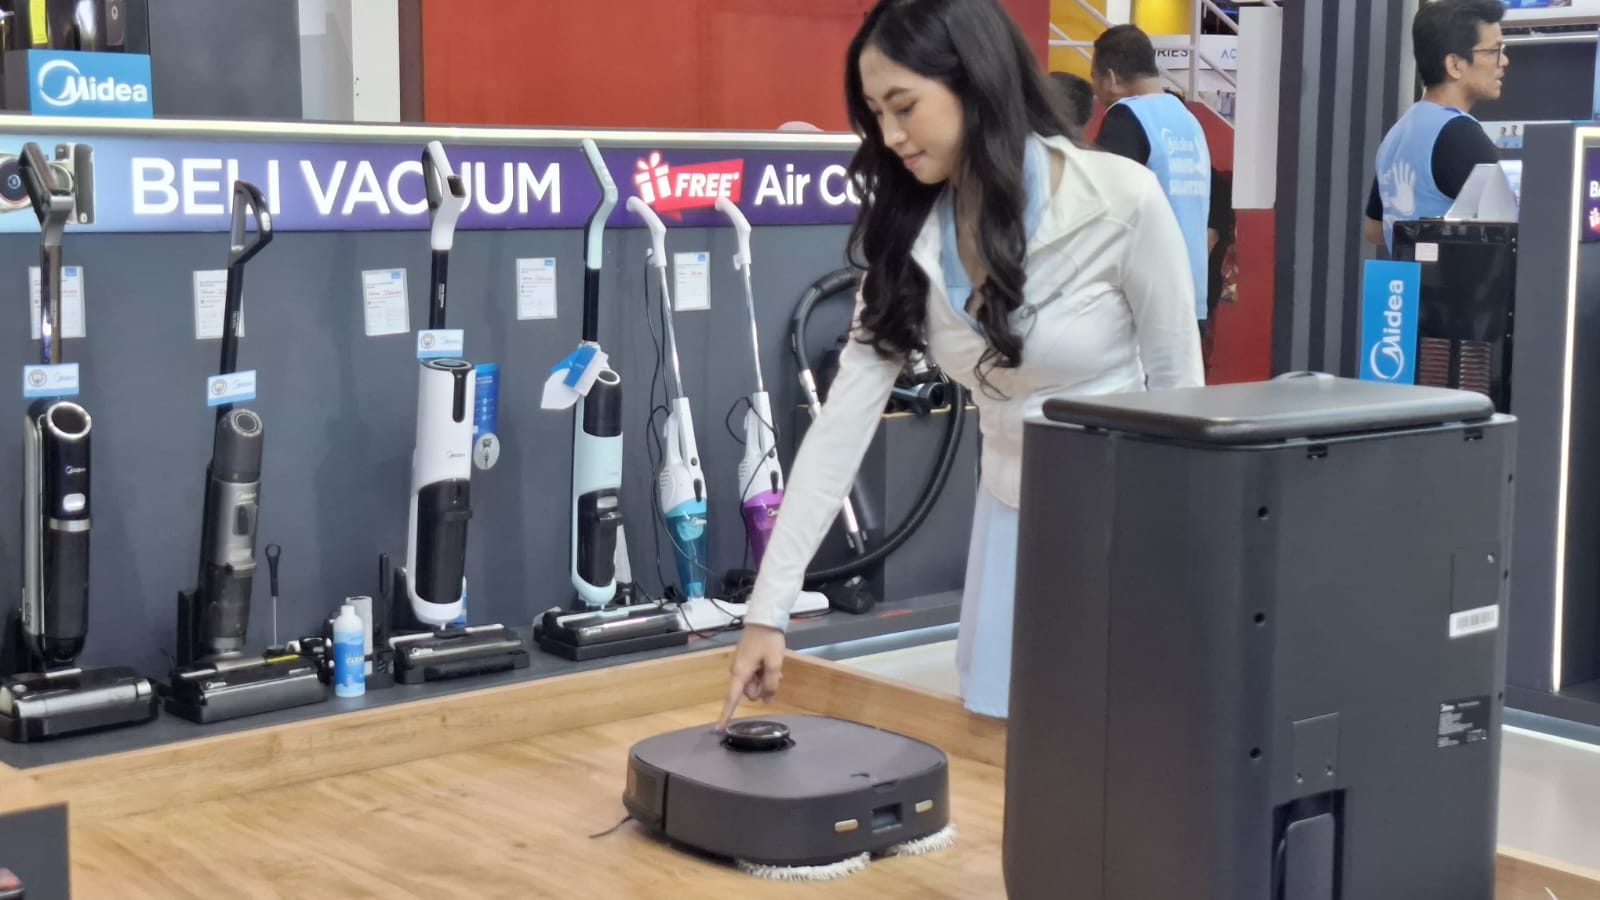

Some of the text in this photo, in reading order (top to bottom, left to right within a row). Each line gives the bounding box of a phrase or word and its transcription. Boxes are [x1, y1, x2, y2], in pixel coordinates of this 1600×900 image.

[1155, 48, 1188, 57] RIES
[38, 59, 148, 107] Midea
[132, 157, 281, 215] BELI
[754, 163, 810, 206] Air
[1370, 279, 1404, 380] Midea
